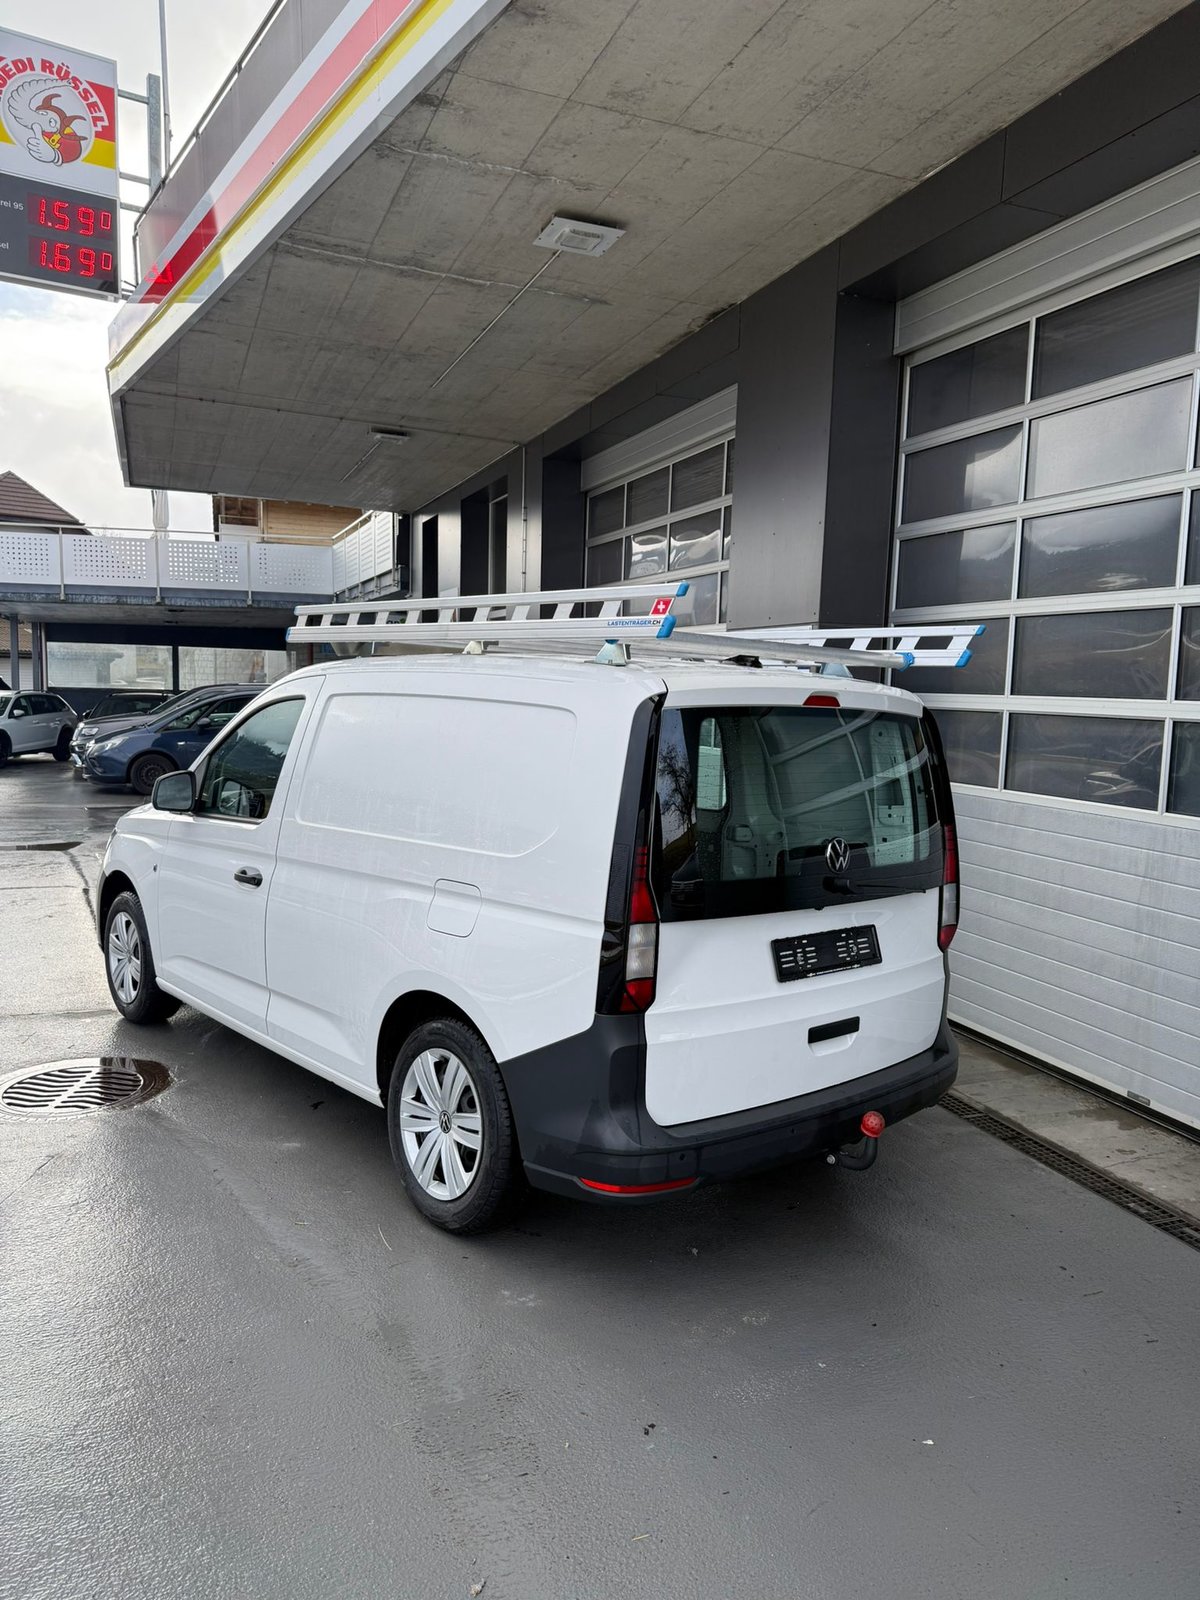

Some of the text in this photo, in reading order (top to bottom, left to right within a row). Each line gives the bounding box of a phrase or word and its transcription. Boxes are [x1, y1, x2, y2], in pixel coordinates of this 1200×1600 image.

[0, 57, 105, 128] UEDI RÜSSEL
[13, 201, 24, 211] 95
